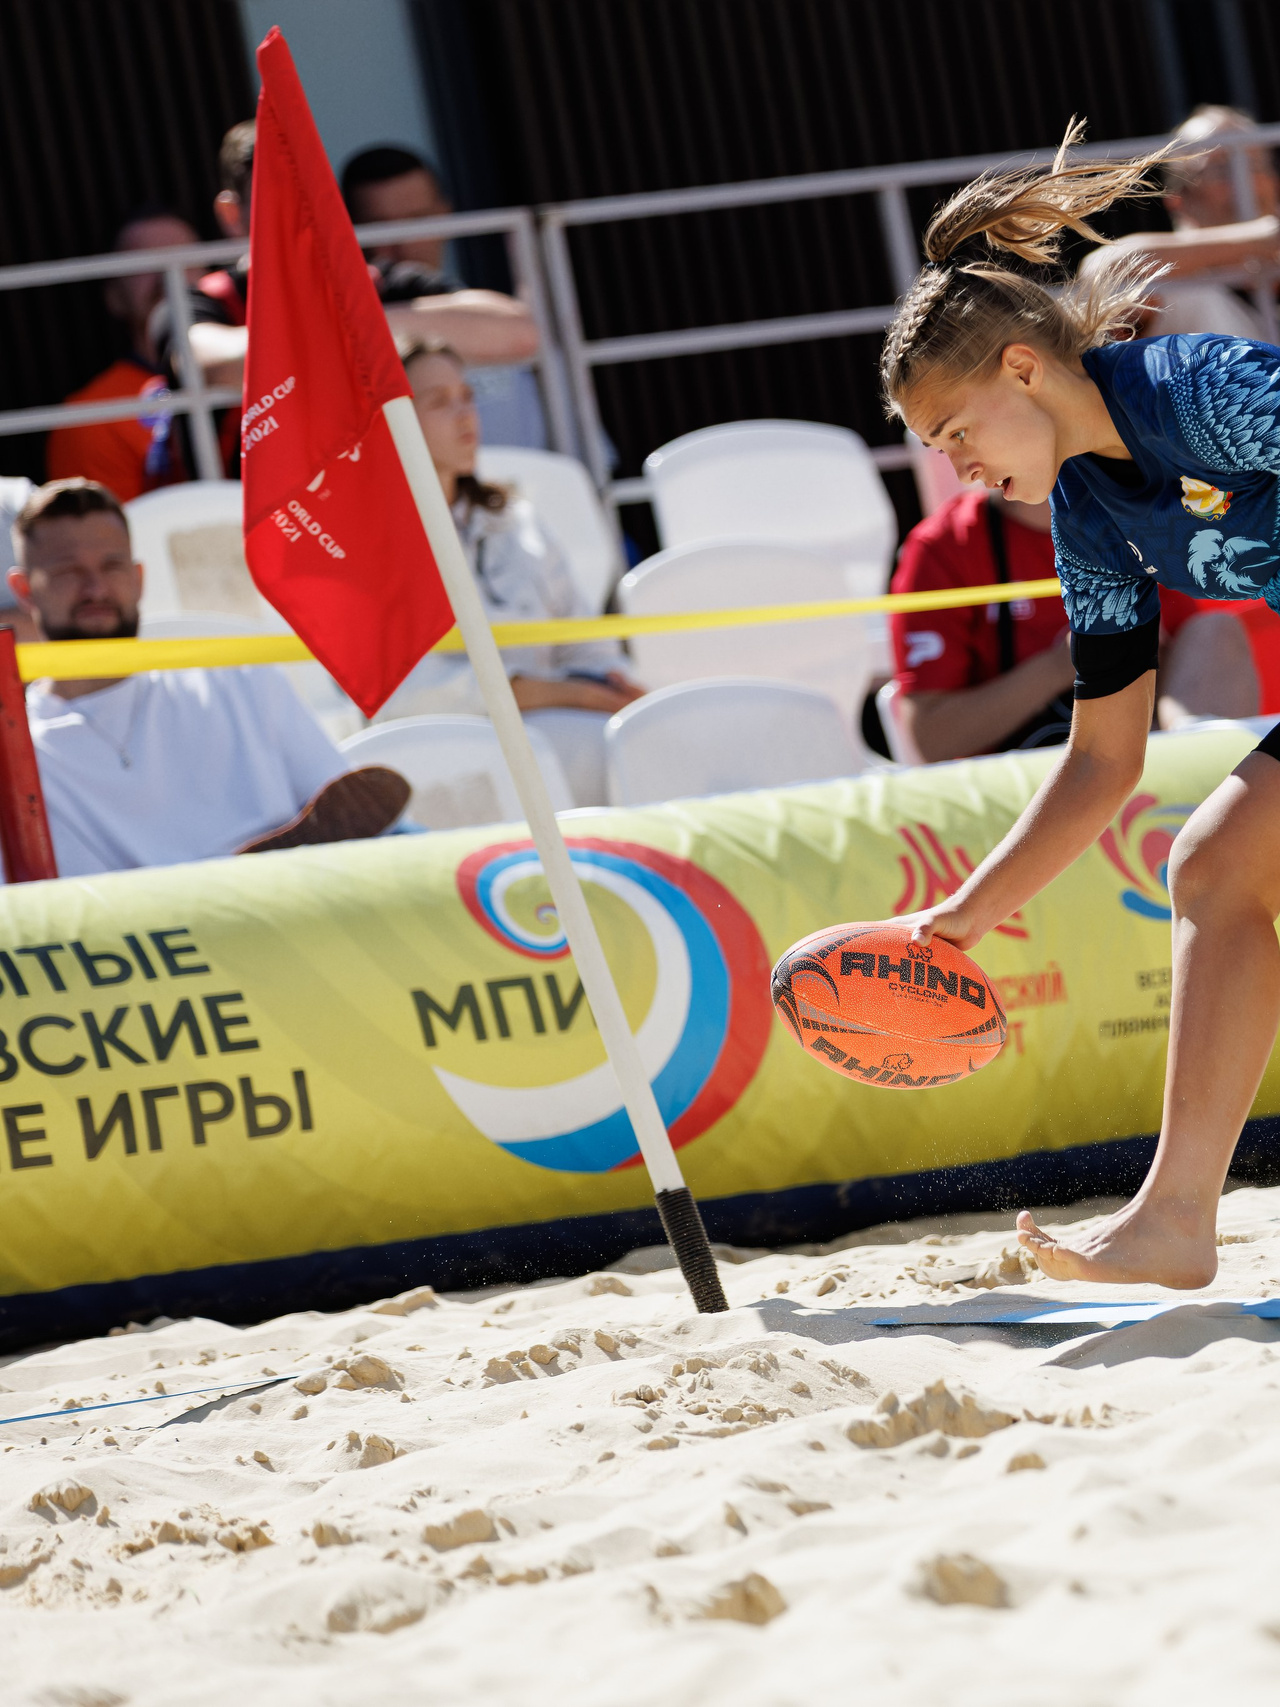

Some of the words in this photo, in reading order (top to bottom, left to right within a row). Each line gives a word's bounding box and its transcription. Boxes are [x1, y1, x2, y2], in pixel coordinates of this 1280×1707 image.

[241, 394, 275, 432] ORLD
[272, 375, 296, 400] CUP
[287, 499, 322, 536] ORLD
[318, 533, 346, 560] CUP
[840, 951, 986, 1009] RHINO
[888, 982, 949, 1003] CYCLONE
[76, 1068, 314, 1162] ИГРЫ
